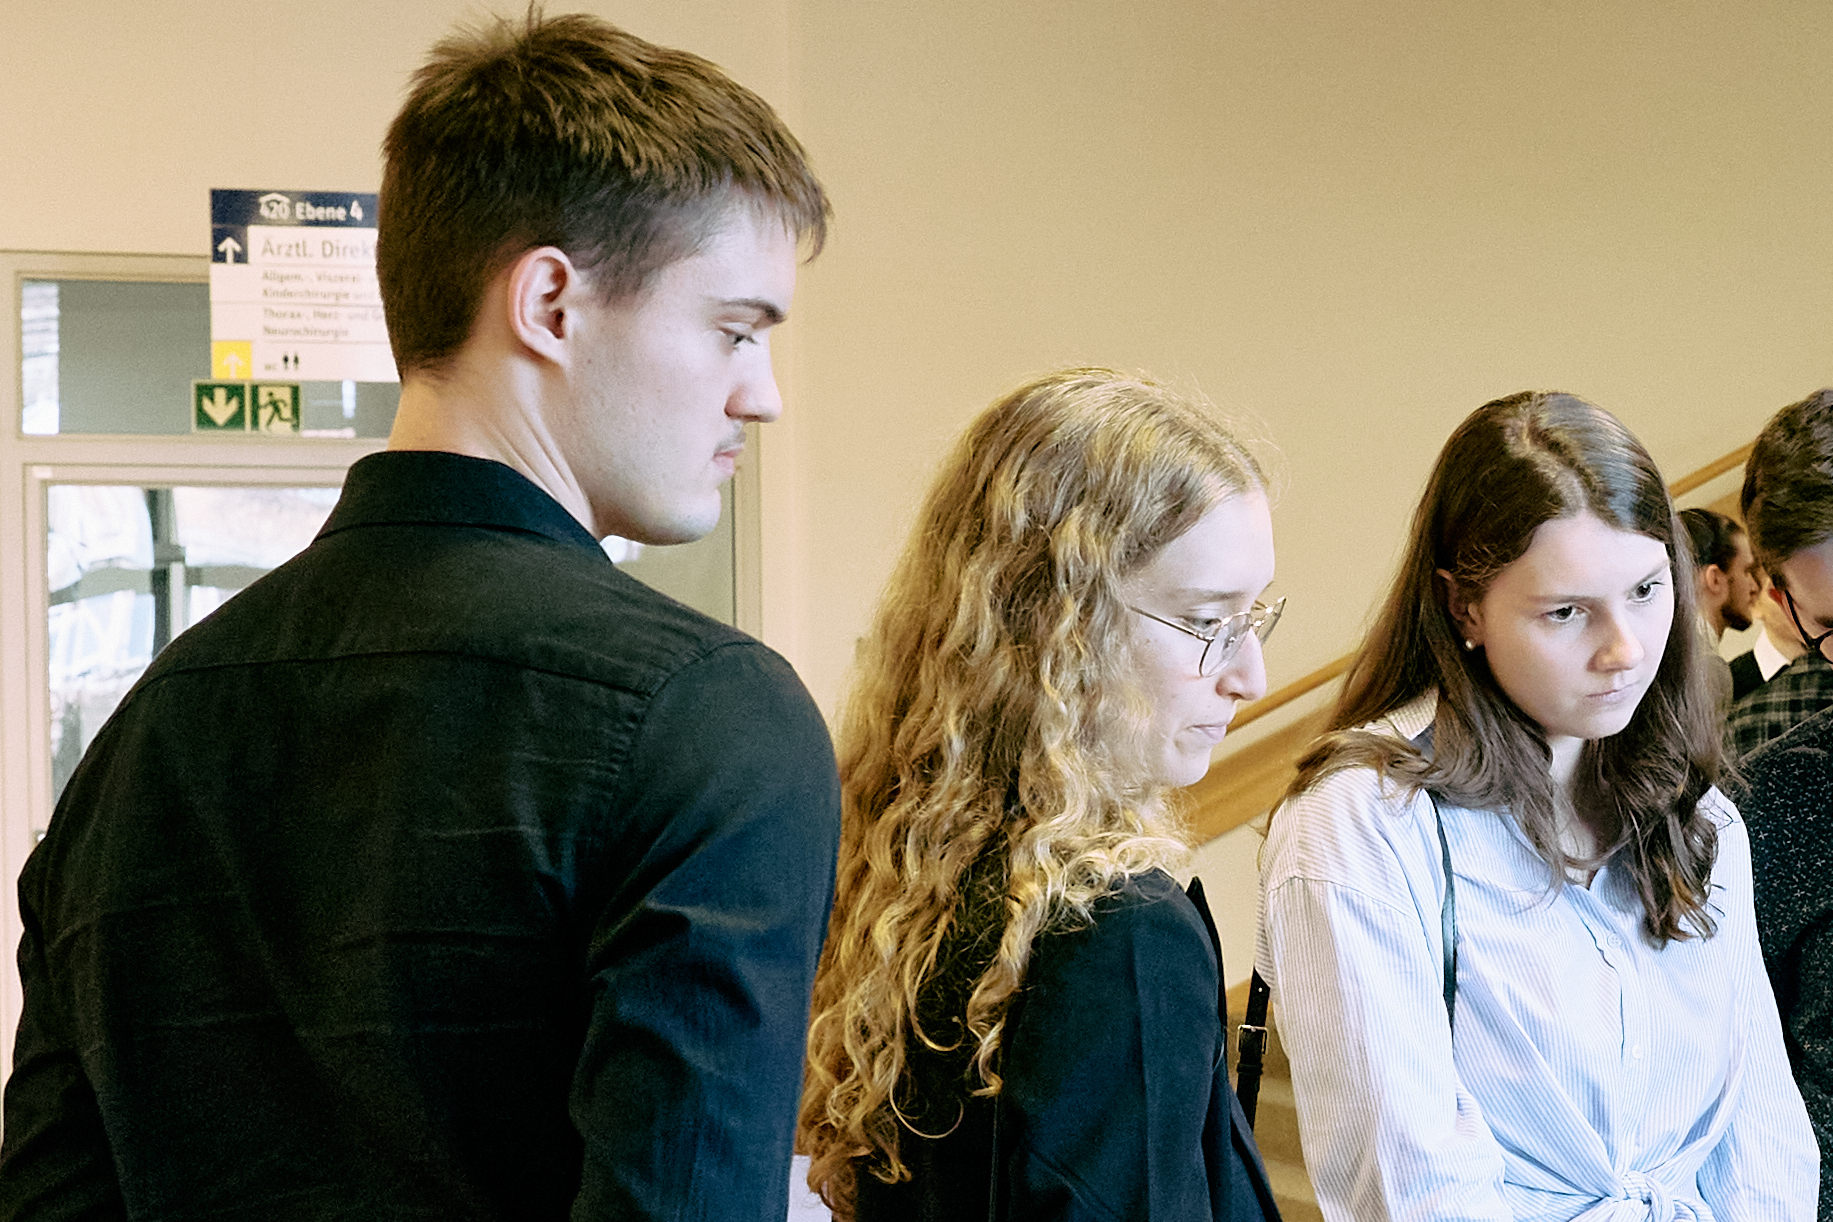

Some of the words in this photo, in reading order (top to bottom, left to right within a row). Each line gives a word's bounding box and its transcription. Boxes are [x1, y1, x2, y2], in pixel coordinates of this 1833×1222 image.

[295, 201, 347, 221] Ebene
[350, 199, 363, 221] 4
[261, 235, 314, 258] Ärztl.
